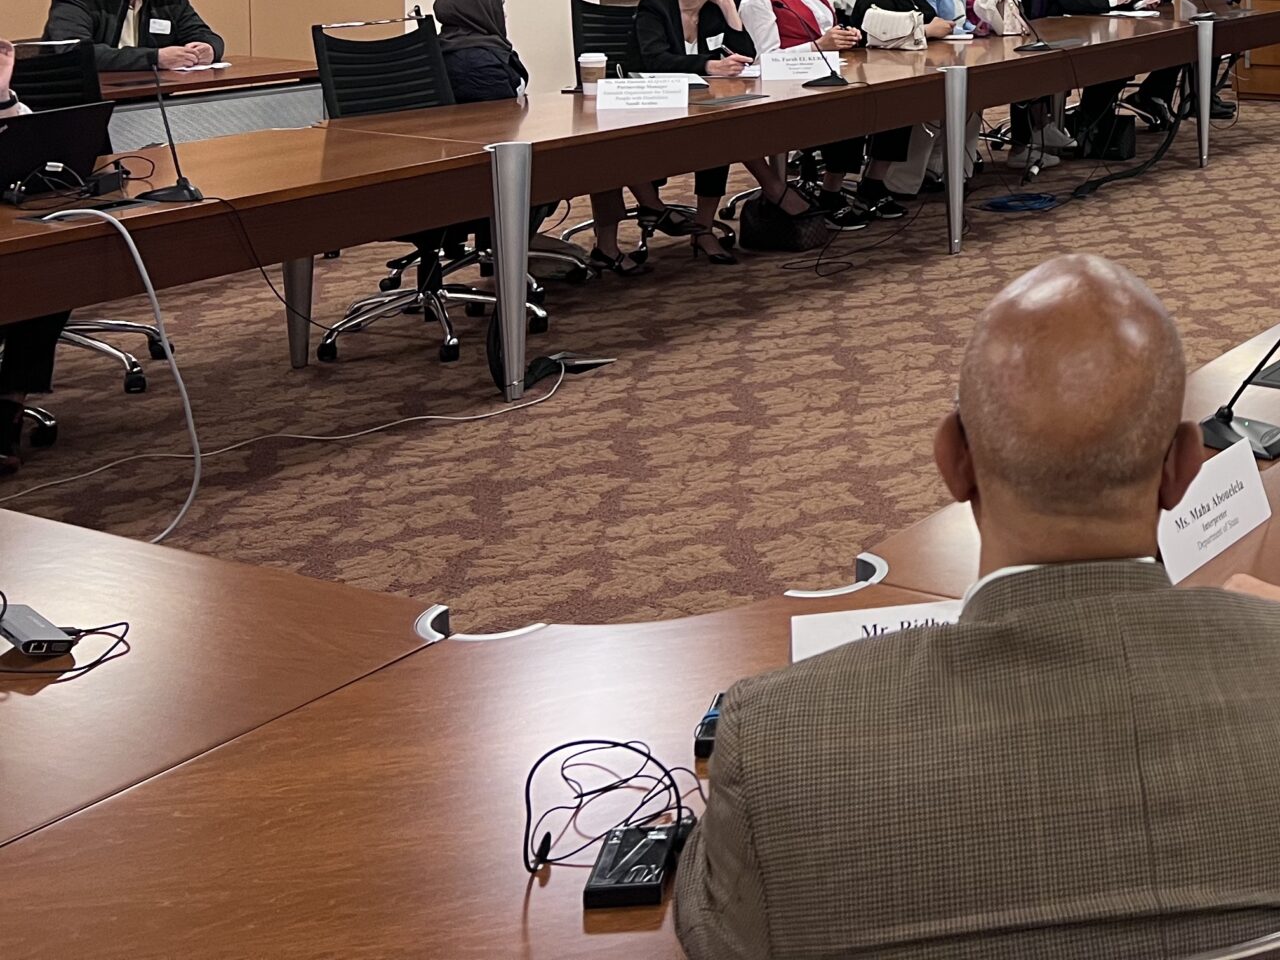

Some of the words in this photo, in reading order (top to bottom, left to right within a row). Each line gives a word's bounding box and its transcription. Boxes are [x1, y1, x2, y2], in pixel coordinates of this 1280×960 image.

[1175, 517, 1190, 533] Ms.
[1190, 502, 1211, 522] Maha
[1212, 480, 1245, 509] Abouelela
[1201, 510, 1228, 532] Interpreter
